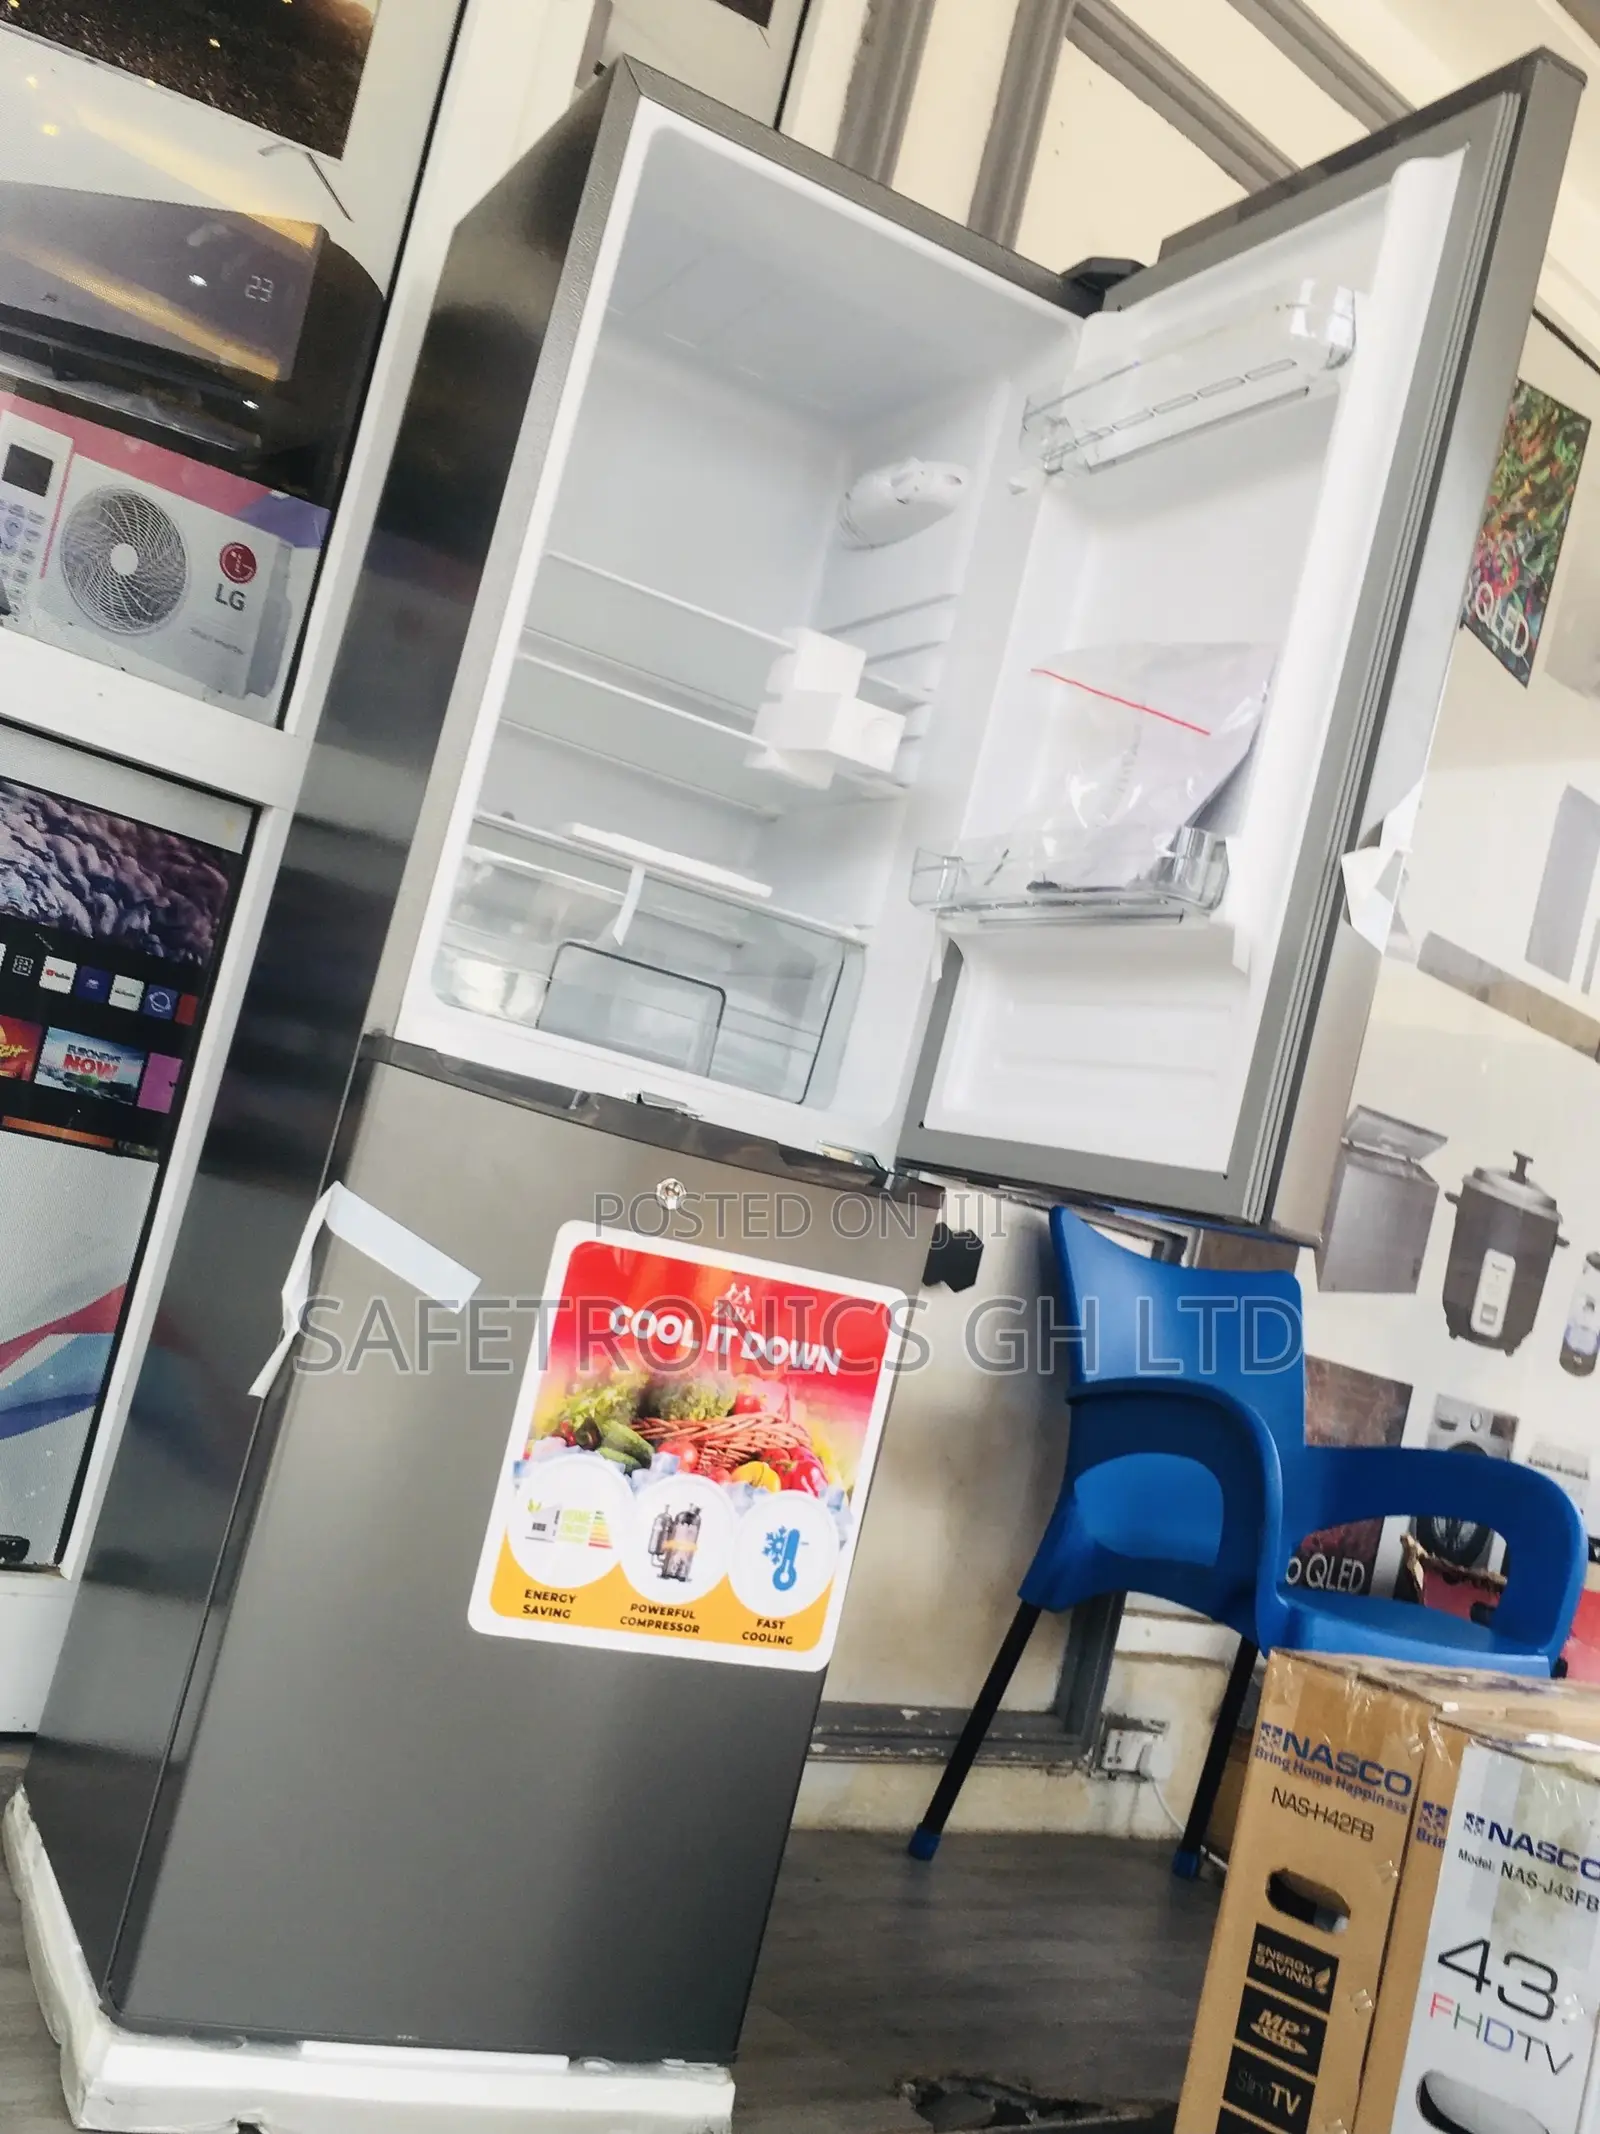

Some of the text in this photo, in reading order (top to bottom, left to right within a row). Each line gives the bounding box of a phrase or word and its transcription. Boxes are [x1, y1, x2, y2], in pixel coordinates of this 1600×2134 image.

[214, 583, 246, 612] LG
[1475, 580, 1529, 658] QLED
[63, 1053, 119, 1078] NOW
[711, 1300, 756, 1326] ZARA
[609, 1304, 844, 1376] COOL IT DOWN
[1306, 1552, 1365, 1593] QLED
[522, 1604, 571, 1620] SAVING
[524, 1588, 577, 1605] ENERGY
[630, 1602, 696, 1620] POWERFUL
[619, 1616, 701, 1635] COMPRESSOR
[741, 1631, 794, 1646] COOLING
[756, 1617, 786, 1631] FAST
[1282, 1731, 1413, 1797] NASCO
[1254, 1746, 1409, 1816] Bring Home Happiness
[1271, 1785, 1375, 1843] NAS-H42FB
[1416, 1827, 1447, 1850] Brin
[1254, 1953, 1313, 1989] SAVING
[1256, 1941, 1315, 1974] ENERGY
[1437, 1936, 1559, 2022] 43
[1430, 1991, 1574, 2076] FHDTV
